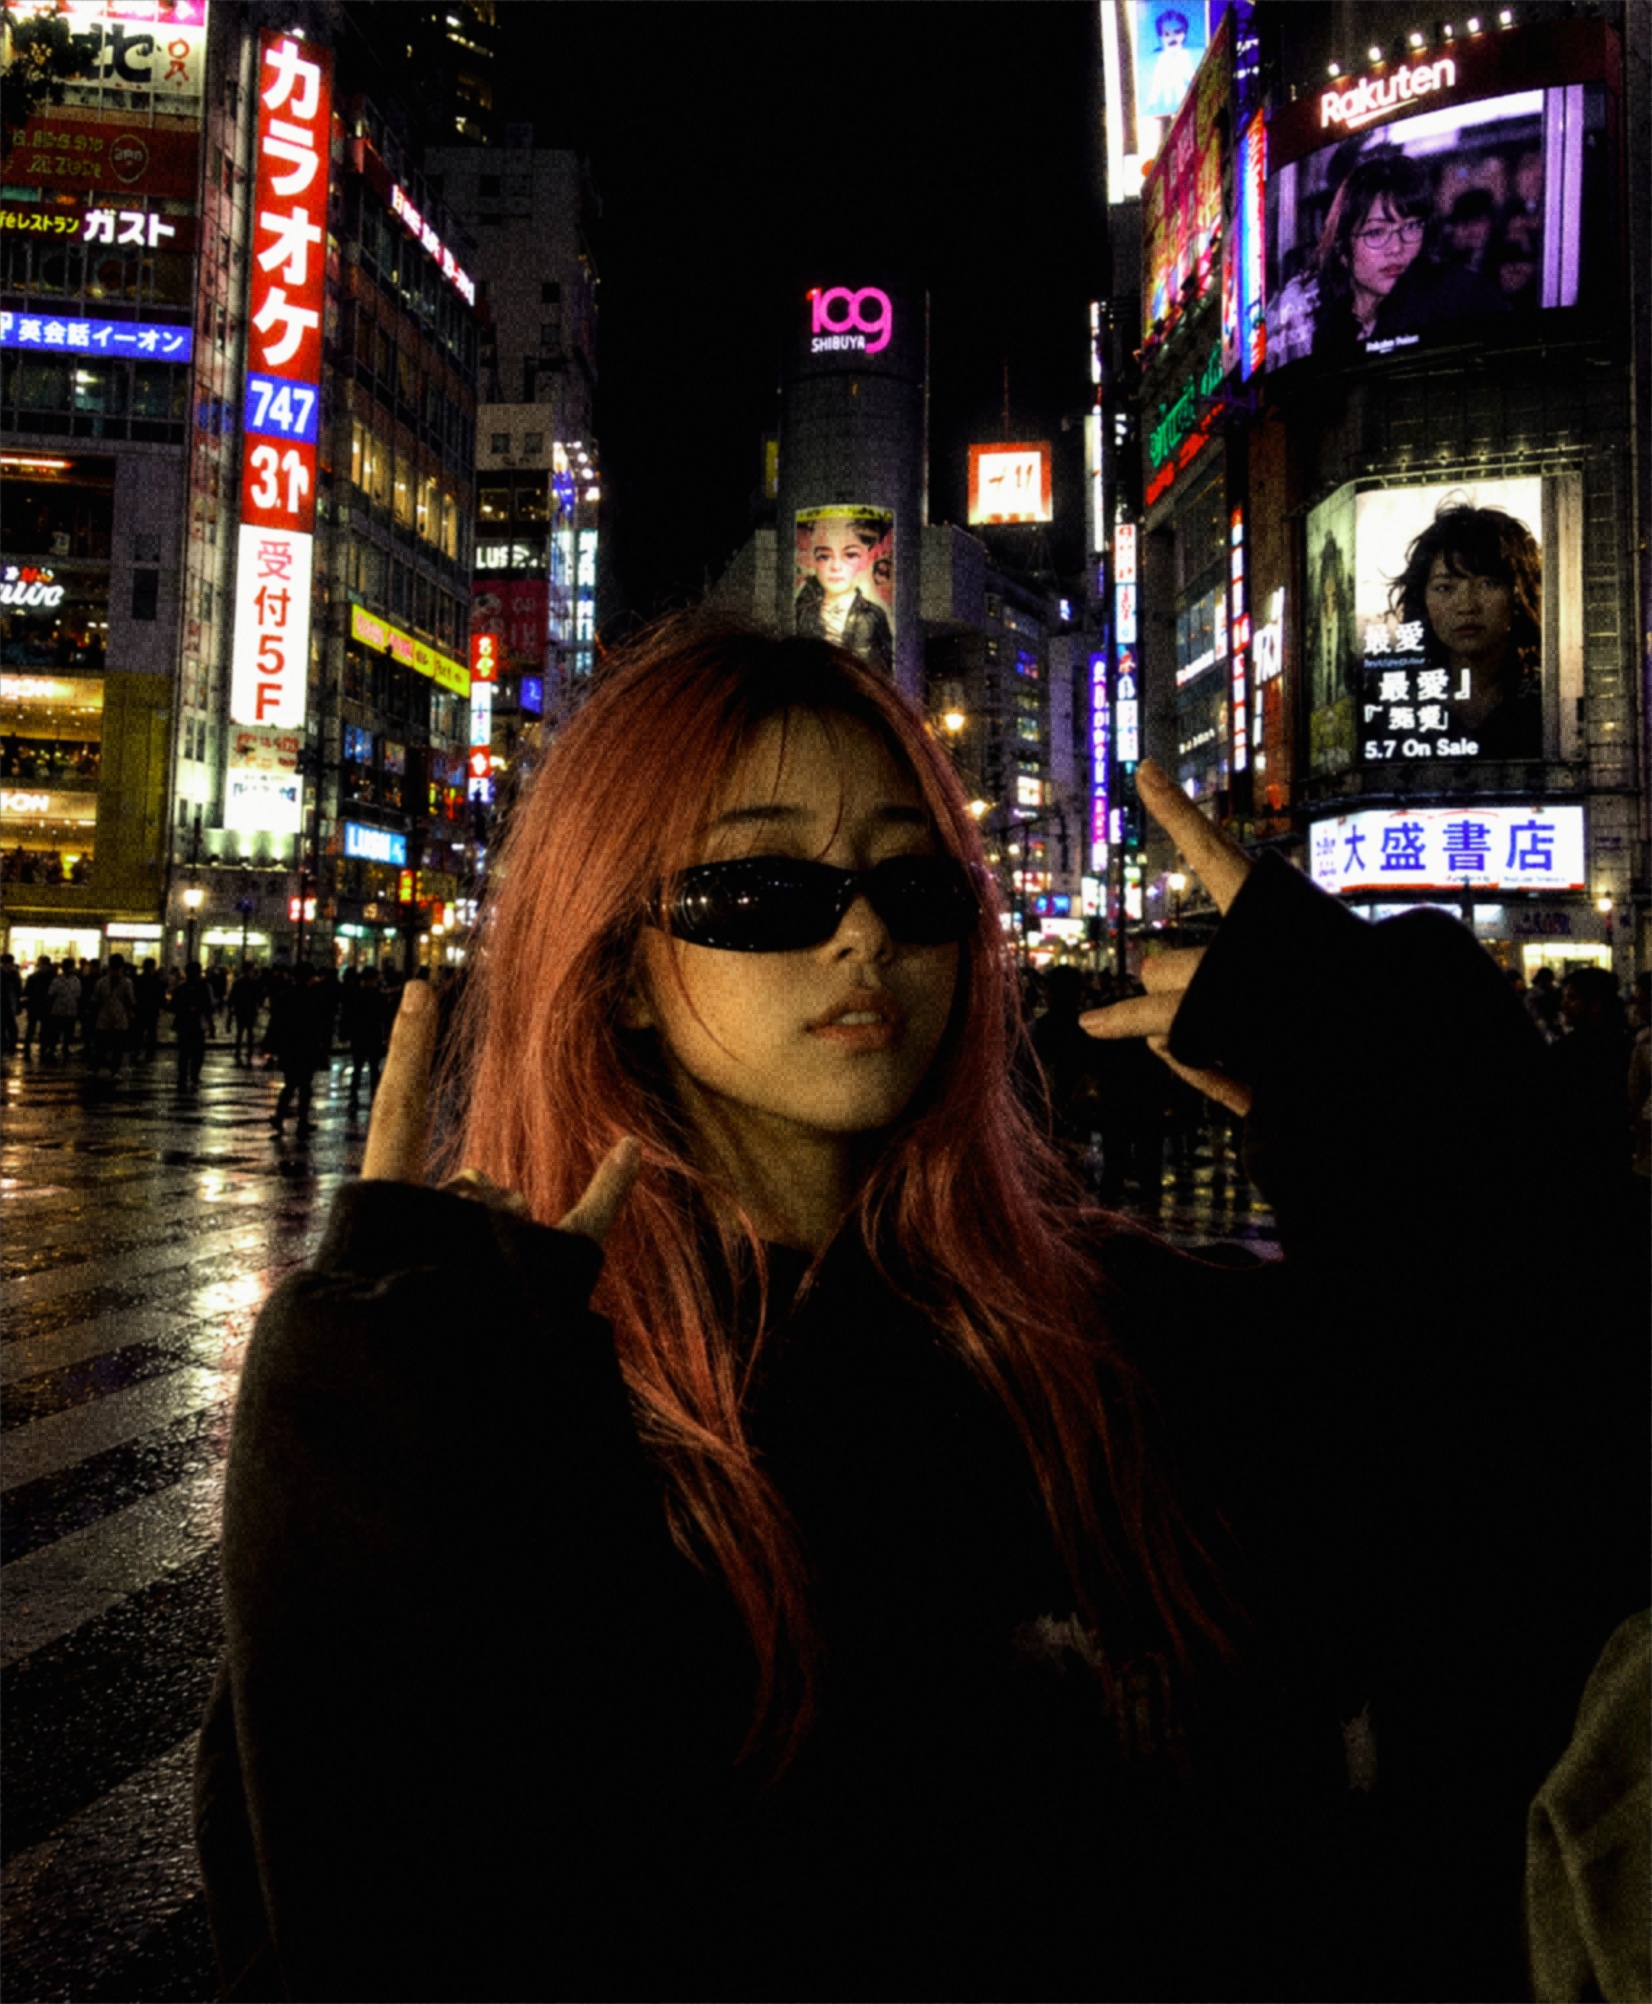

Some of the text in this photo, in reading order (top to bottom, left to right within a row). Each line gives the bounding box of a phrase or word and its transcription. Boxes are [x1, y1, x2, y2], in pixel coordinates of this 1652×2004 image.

[1320, 57, 1456, 129] Rakuten
[83, 208, 175, 248] ガスト
[251, 38, 322, 367] カラオケ
[18, 318, 184, 352] 英会話イーオン
[806, 286, 893, 354] 109
[810, 335, 866, 353] SHIBUYA
[251, 380, 315, 434] 747
[1364, 737, 1479, 759] 5.7 On Sale
[1344, 819, 1557, 875] 大盛書店
